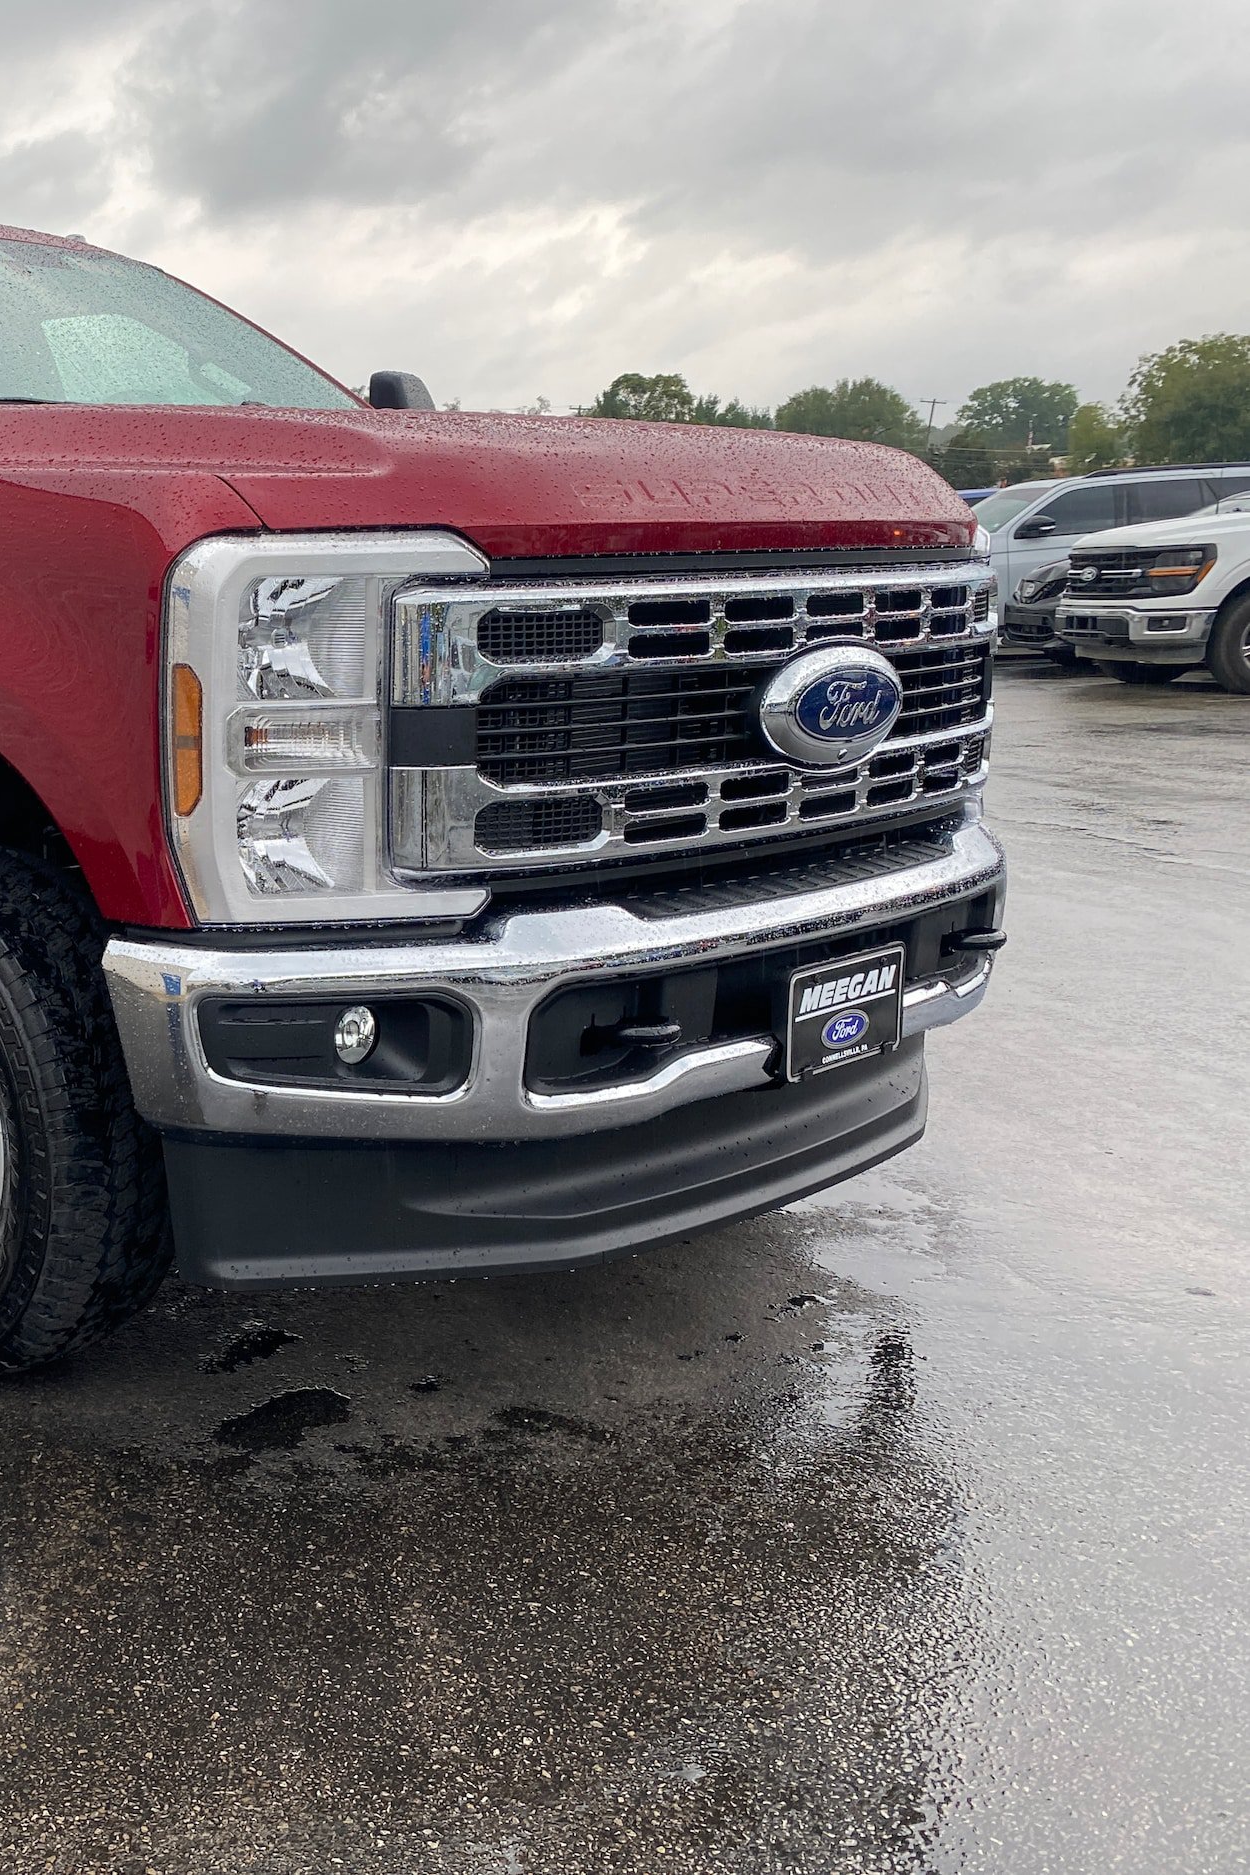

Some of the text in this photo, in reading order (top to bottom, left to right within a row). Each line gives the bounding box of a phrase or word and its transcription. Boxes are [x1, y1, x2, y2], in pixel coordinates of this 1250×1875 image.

[819, 680, 883, 731] Ford
[799, 965, 897, 1014] MEEGAN
[832, 1016, 859, 1041] Ford
